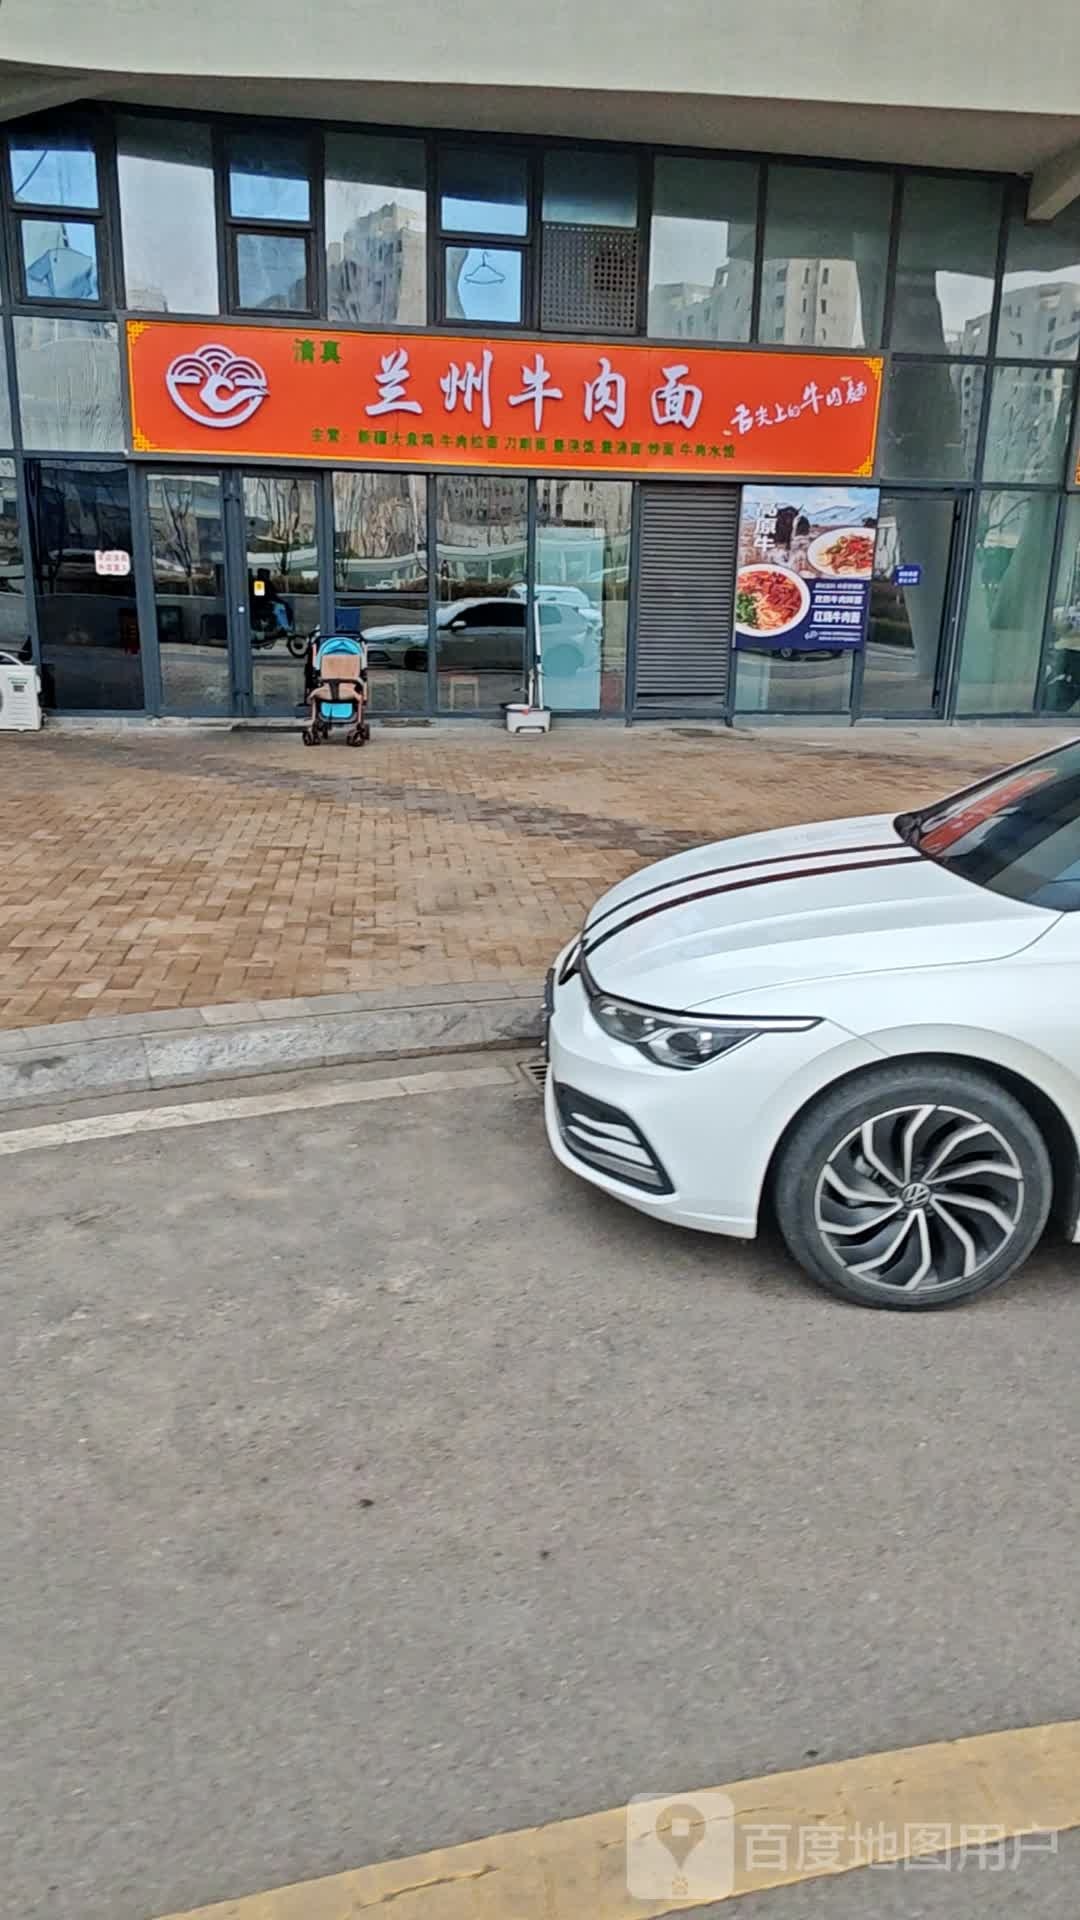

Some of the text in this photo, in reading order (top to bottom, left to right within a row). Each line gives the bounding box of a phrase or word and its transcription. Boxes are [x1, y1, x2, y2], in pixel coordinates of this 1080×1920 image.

[293, 337, 342, 364] 清真
[365, 348, 703, 431] 兰州牛肉面
